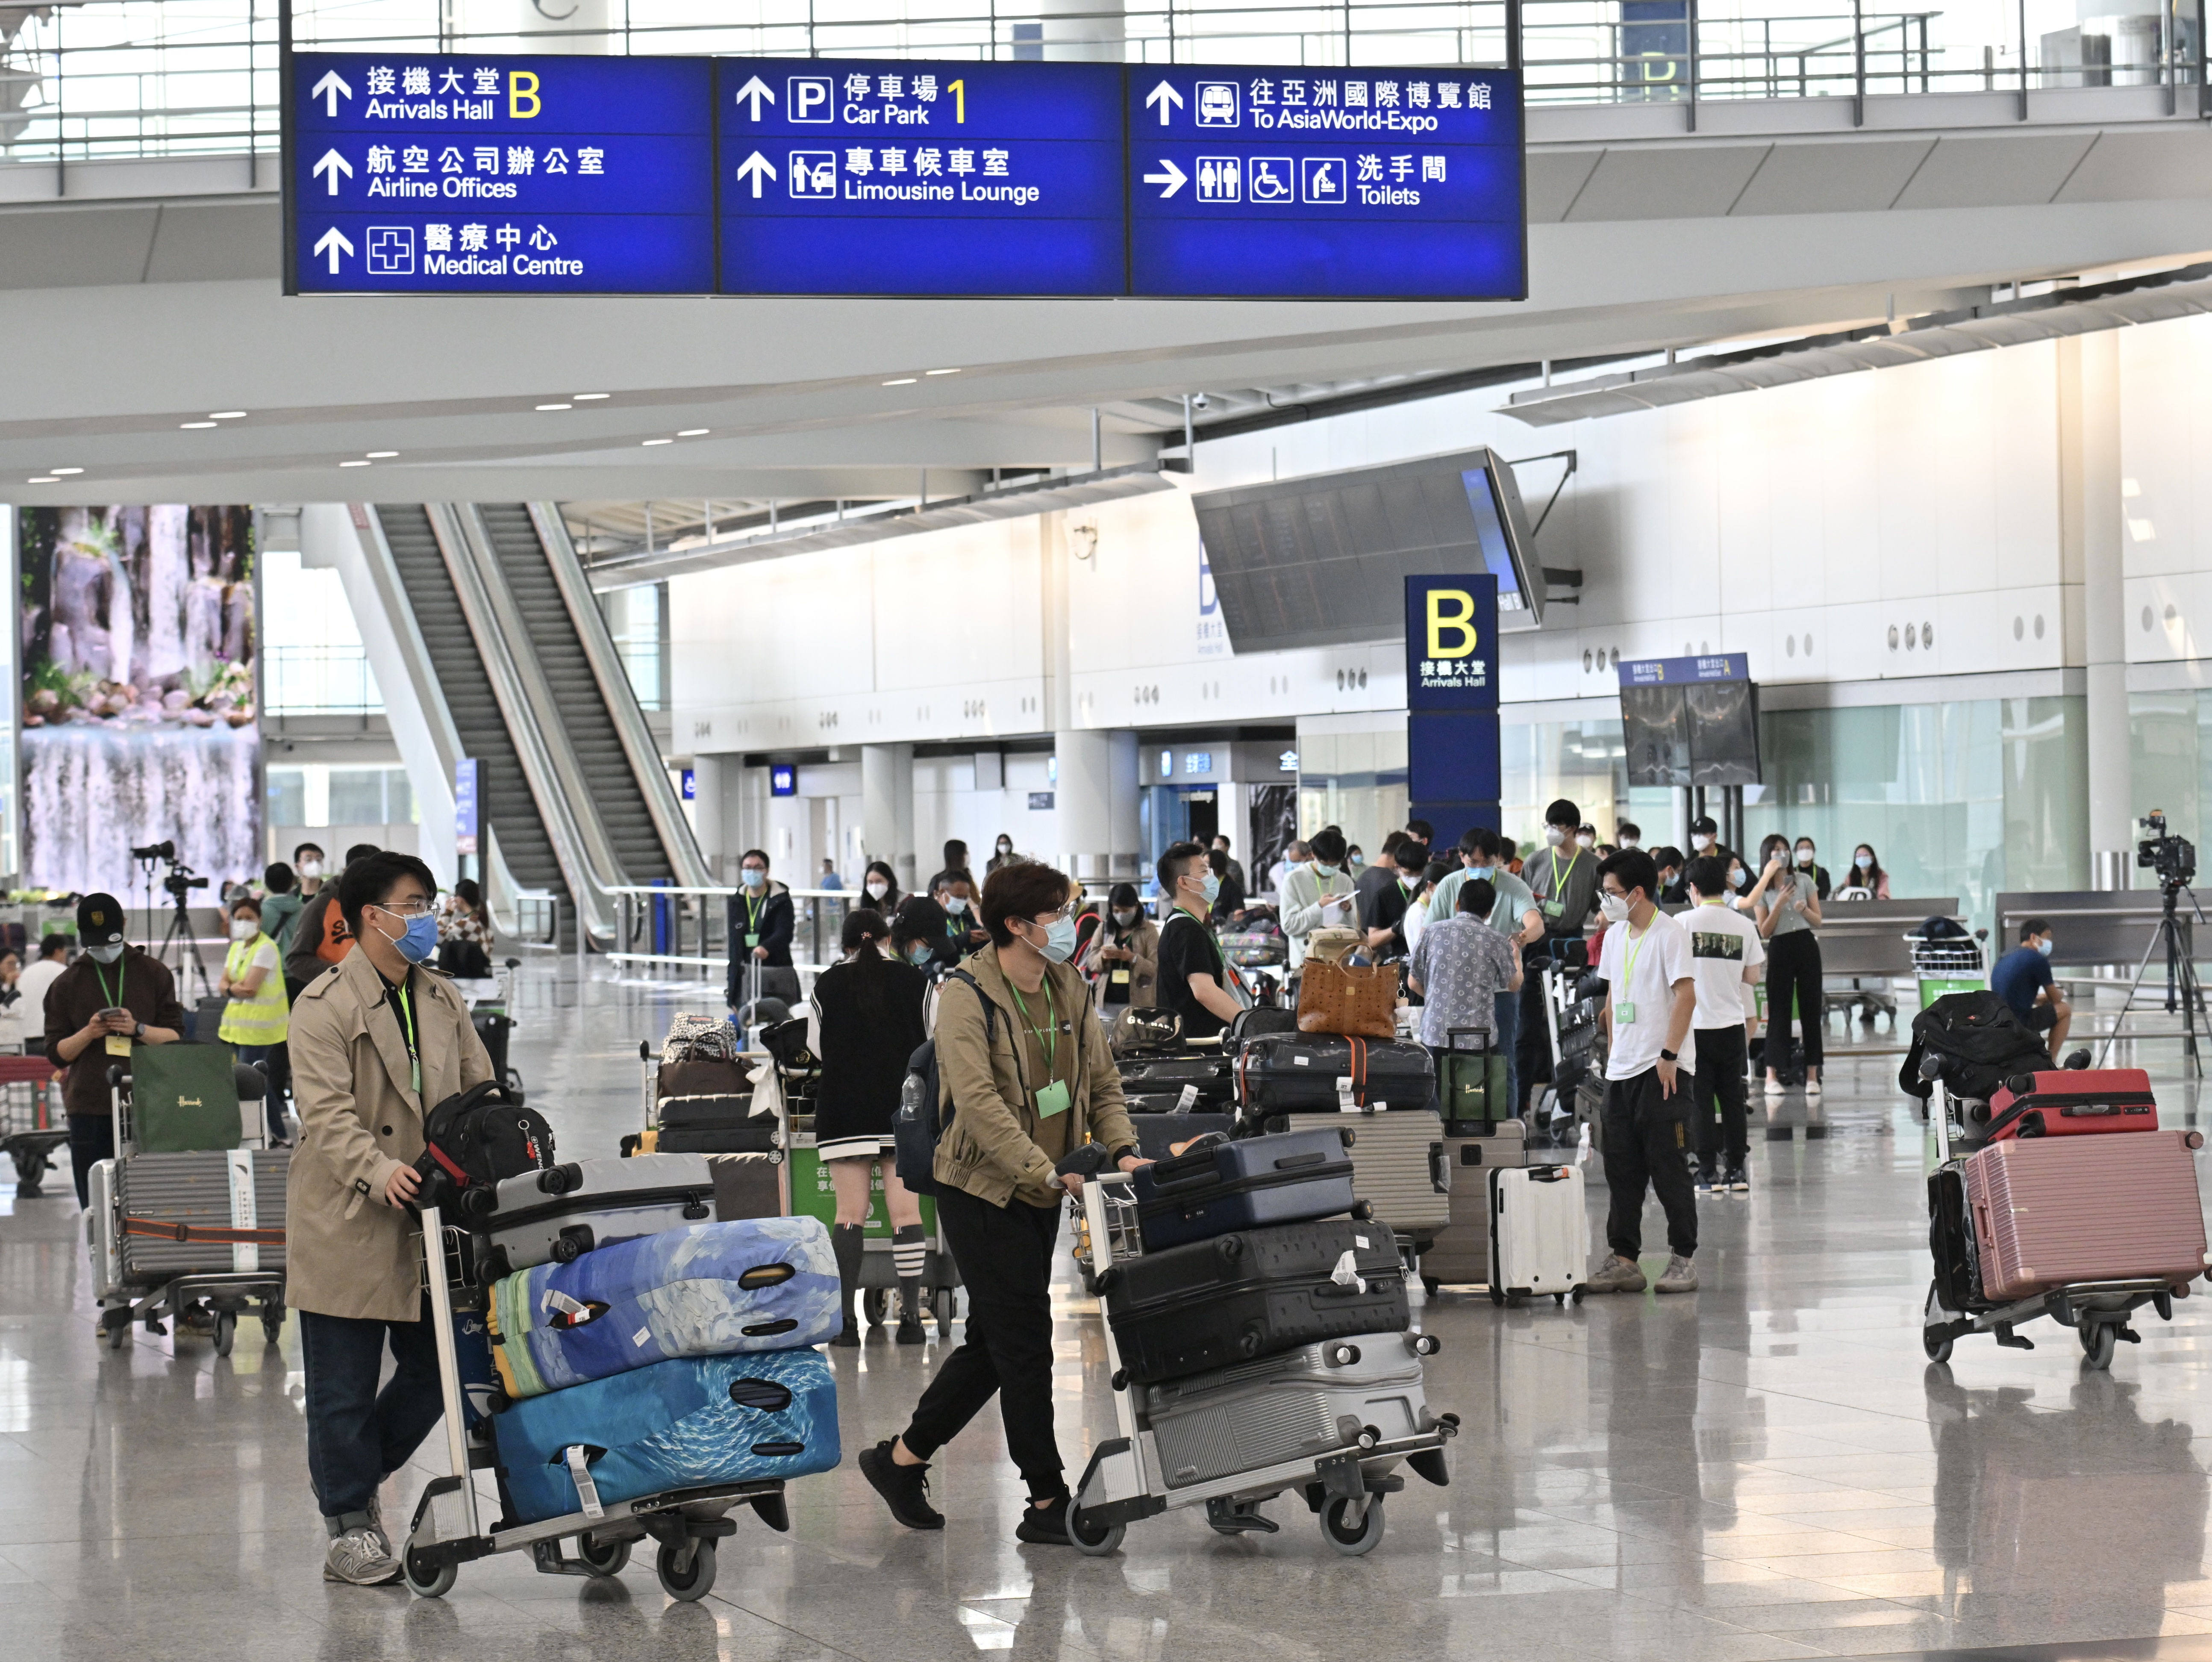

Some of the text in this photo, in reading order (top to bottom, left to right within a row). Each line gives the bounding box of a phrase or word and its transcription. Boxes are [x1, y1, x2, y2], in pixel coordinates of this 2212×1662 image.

[367, 66, 500, 95] 接機大堂
[509, 71, 541, 118] B
[844, 74, 938, 102] 停車場
[1250, 79, 1491, 110] 往亞洲國際博覽館
[365, 98, 493, 120] Arrivals Hall
[843, 104, 929, 124] Car Park
[947, 80, 965, 124] 1
[1250, 109, 1438, 134] To AsiaWorld-Expo
[367, 145, 604, 175] 航空公司辦公室
[845, 147, 1009, 177] 專車候車室
[1356, 153, 1446, 183] 洗手間
[368, 177, 517, 198] Airline Offices
[845, 180, 1039, 206] Limousine Lounge
[1356, 185, 1420, 205] Toilets
[424, 223, 558, 252] 醫療中心
[424, 254, 583, 276] Medical Centre
[1427, 590, 1477, 658] B
[1420, 660, 1485, 676] 接機大堂
[1421, 677, 1485, 687] Arrivals Hall
